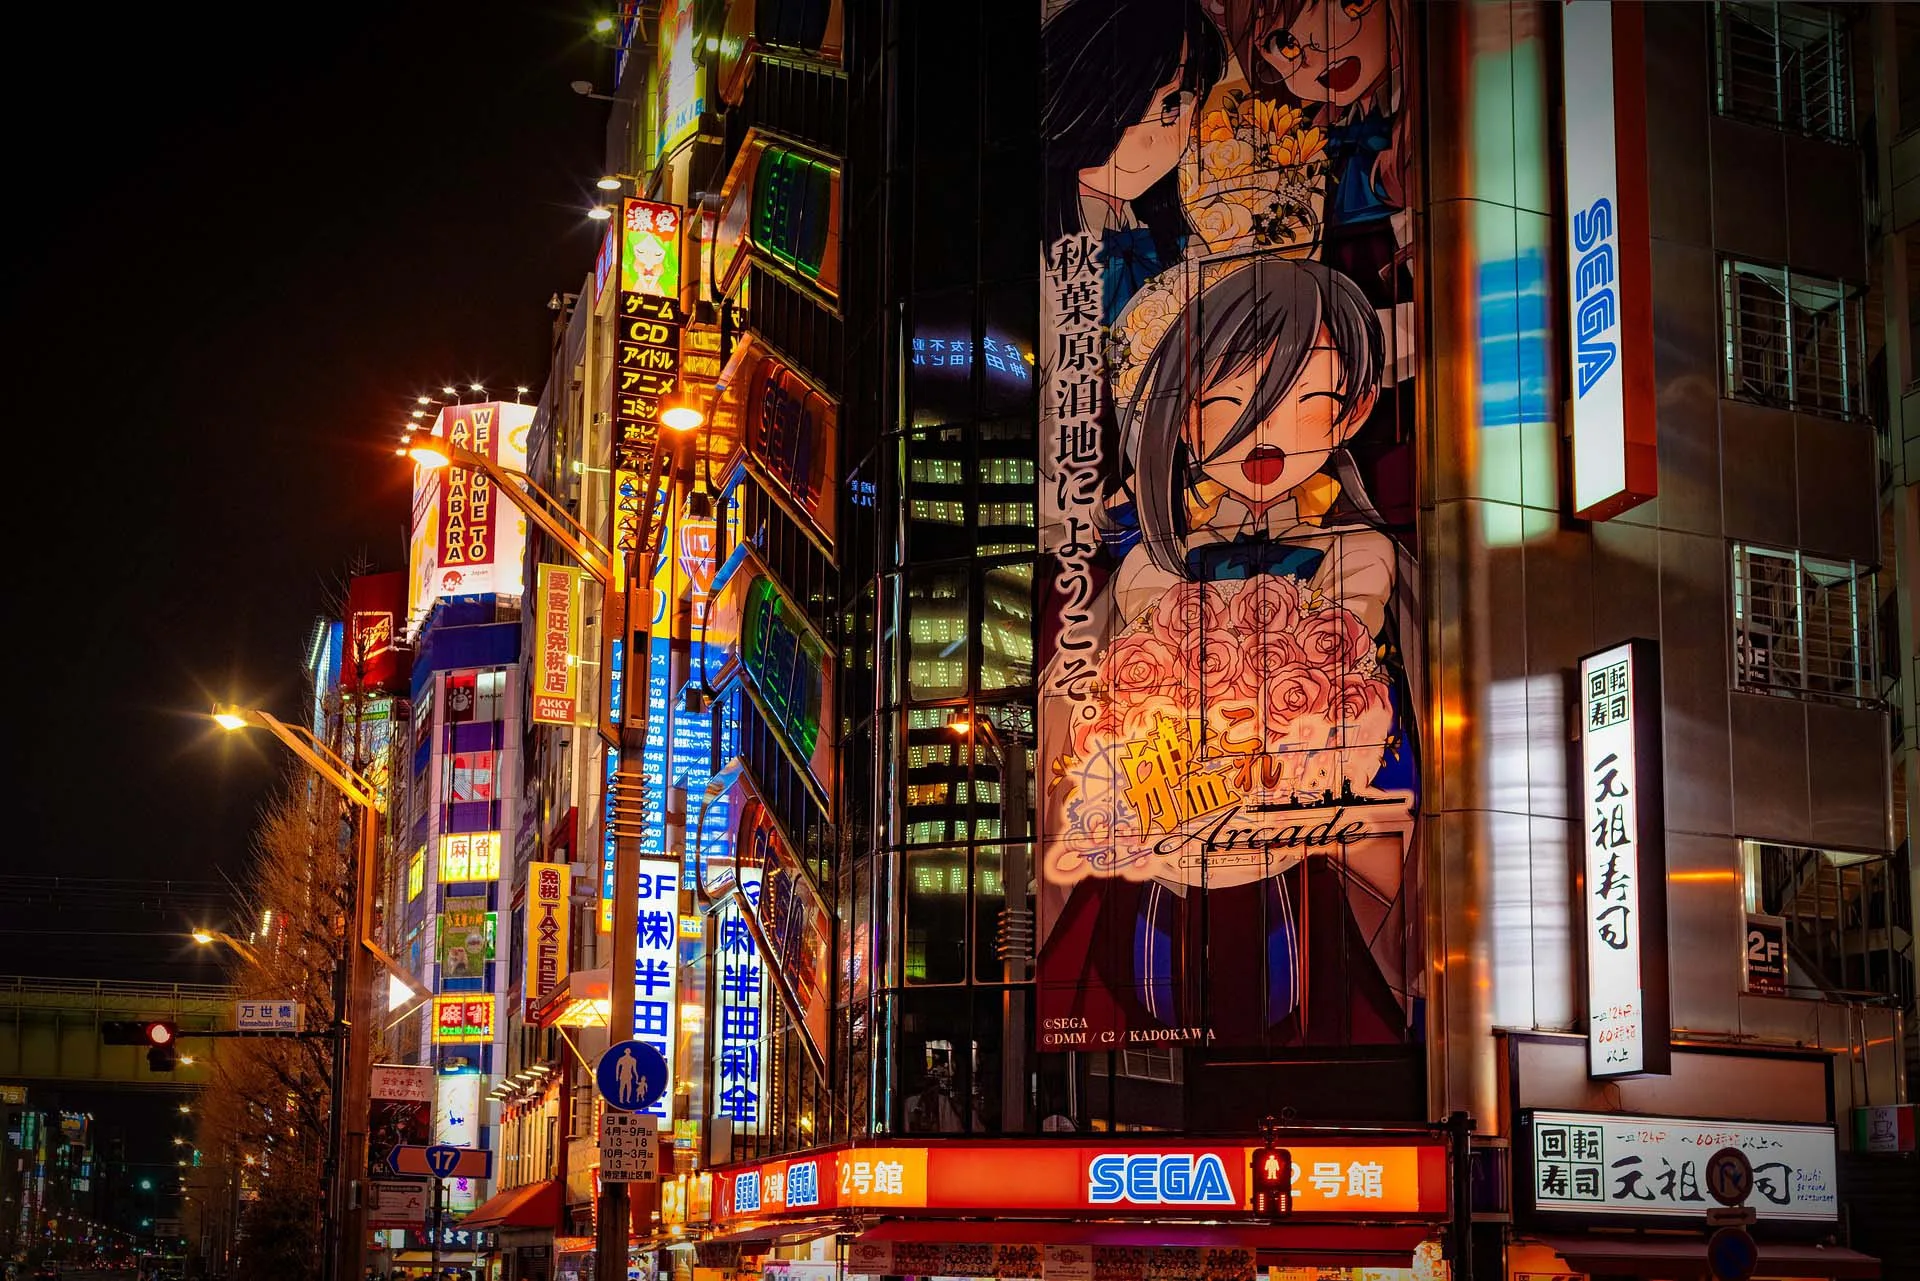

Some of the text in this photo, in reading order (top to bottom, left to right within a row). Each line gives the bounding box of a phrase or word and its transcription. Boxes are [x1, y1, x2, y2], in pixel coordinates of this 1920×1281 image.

[626, 295, 674, 320] ゲーム
[1574, 198, 1616, 400] SEGA
[630, 321, 669, 344] CD
[624, 346, 673, 370] アイドル
[621, 371, 675, 395] アニメ
[622, 399, 657, 419] コミッ
[449, 422, 466, 561] AKHABARA
[1055, 235, 1099, 721] 秋葉原泊地にようこそ。
[471, 527, 487, 558] TO
[539, 698, 571, 709] AKKY
[542, 709, 568, 719] ONE
[1153, 804, 1370, 857] Arcade
[451, 839, 489, 858] 麻雀
[1592, 753, 1631, 951] 元祖寿司
[540, 868, 561, 899] 免税
[538, 902, 559, 944] TAX
[1748, 930, 1779, 962] 2F
[241, 1004, 291, 1018] 万世橋
[1101, 1031, 1115, 1043] C2
[1540, 1128, 1600, 1160] 回転
[433, 1151, 455, 1171] 17
[734, 1170, 760, 1213] SEGA
[785, 1160, 818, 1207] SEGA
[842, 1160, 904, 1195] 2号館
[1088, 1153, 1236, 1205] SEGA
[1541, 1165, 1601, 1197] 寿司
[1611, 1155, 1792, 1205] 元祖司
